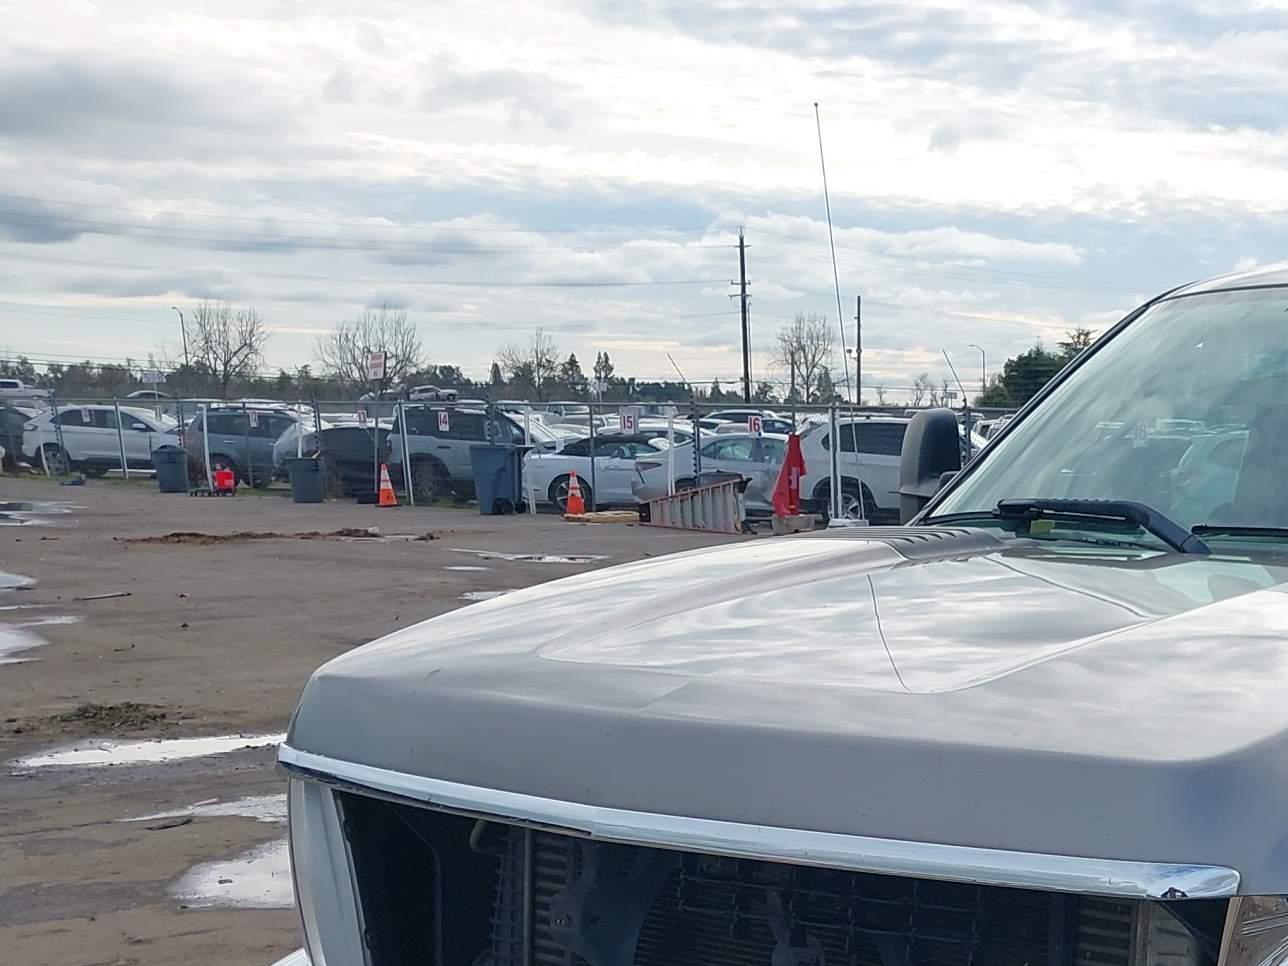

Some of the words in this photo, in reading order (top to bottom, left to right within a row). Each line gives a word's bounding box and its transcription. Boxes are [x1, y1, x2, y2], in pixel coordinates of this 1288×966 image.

[439, 412, 448, 425] 14
[622, 415, 633, 430] 15
[749, 417, 761, 432] 16
